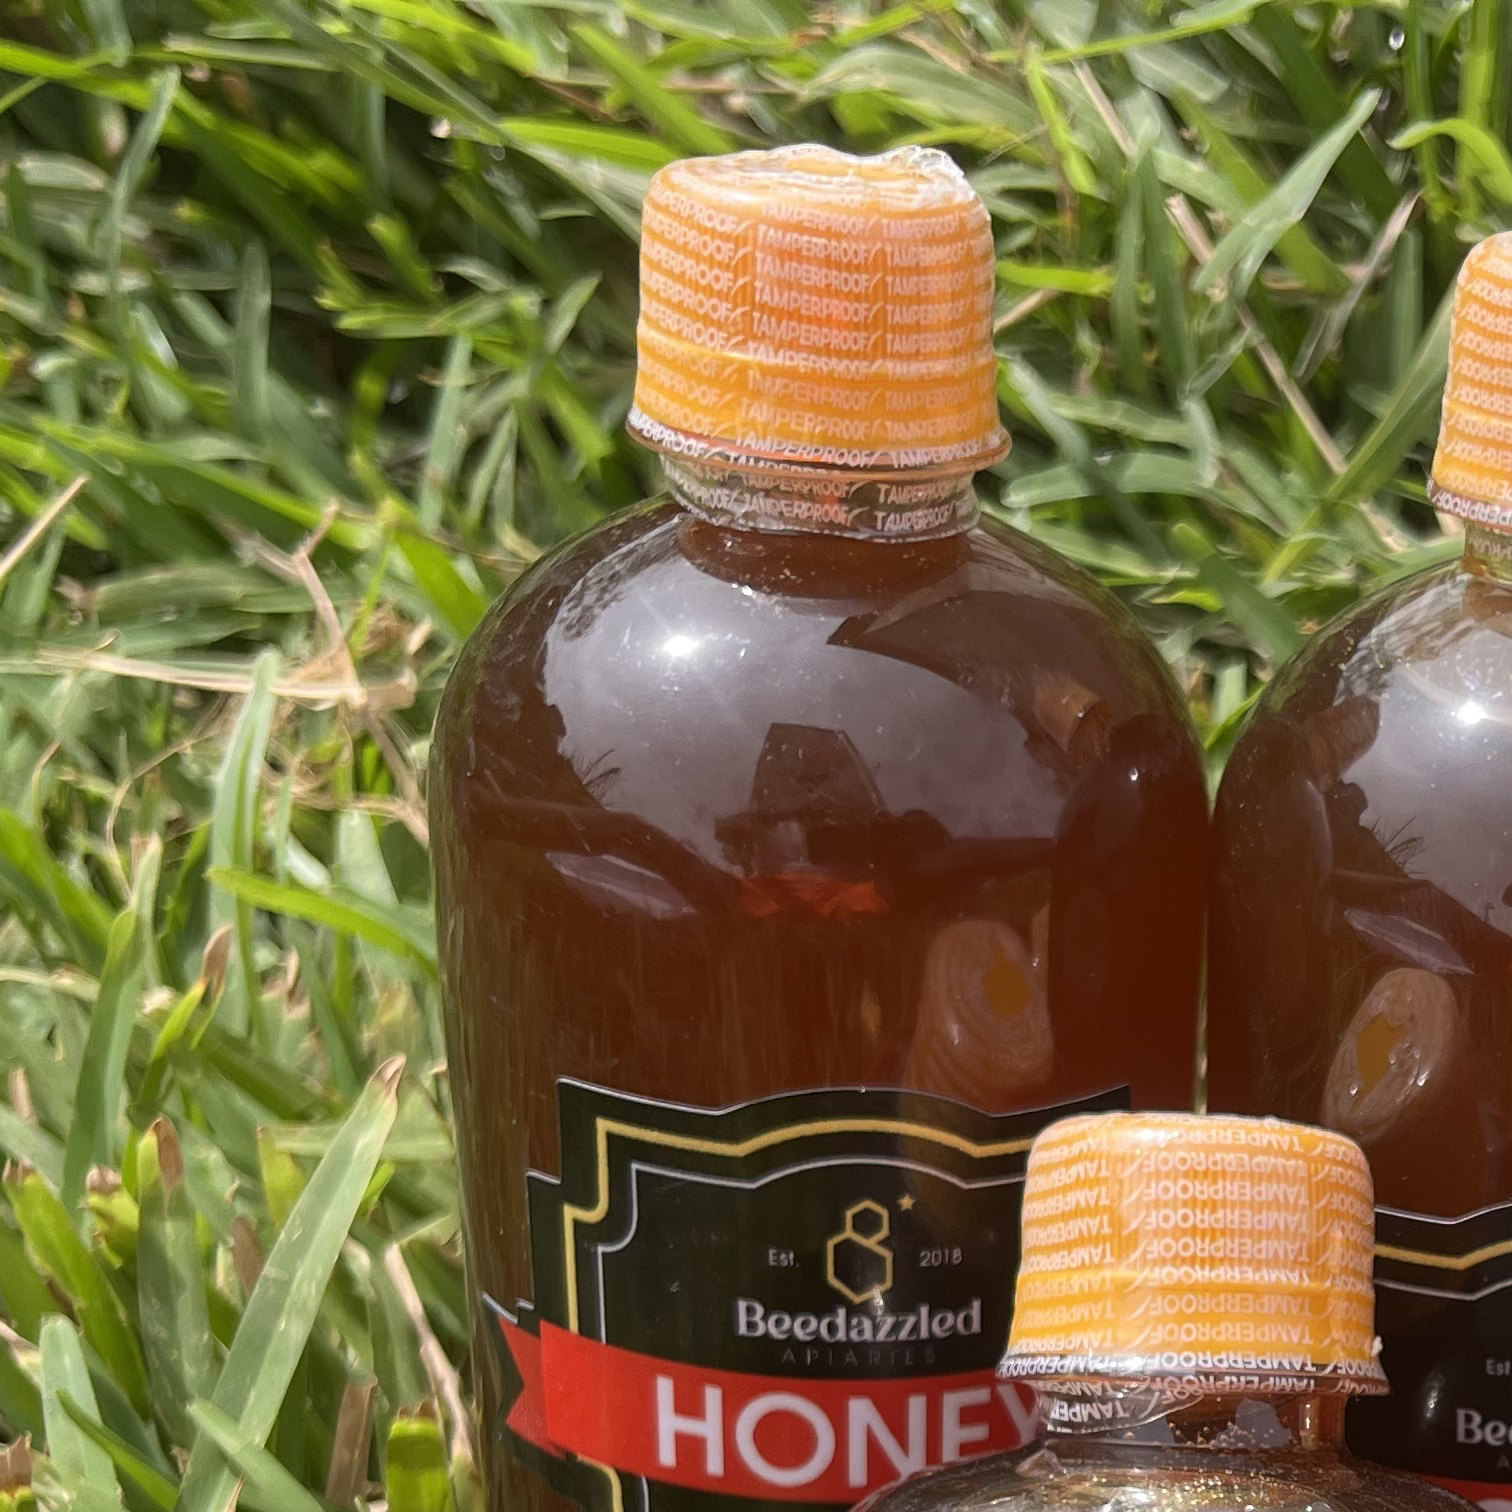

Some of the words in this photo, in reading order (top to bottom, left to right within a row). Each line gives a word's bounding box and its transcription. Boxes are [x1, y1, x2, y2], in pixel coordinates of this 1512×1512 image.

[768, 1248, 800, 1268] Est.
[920, 1248, 962, 1267] 2018
[737, 1298, 983, 1343] Beedazzled
[782, 1346, 937, 1367] APIARIES
